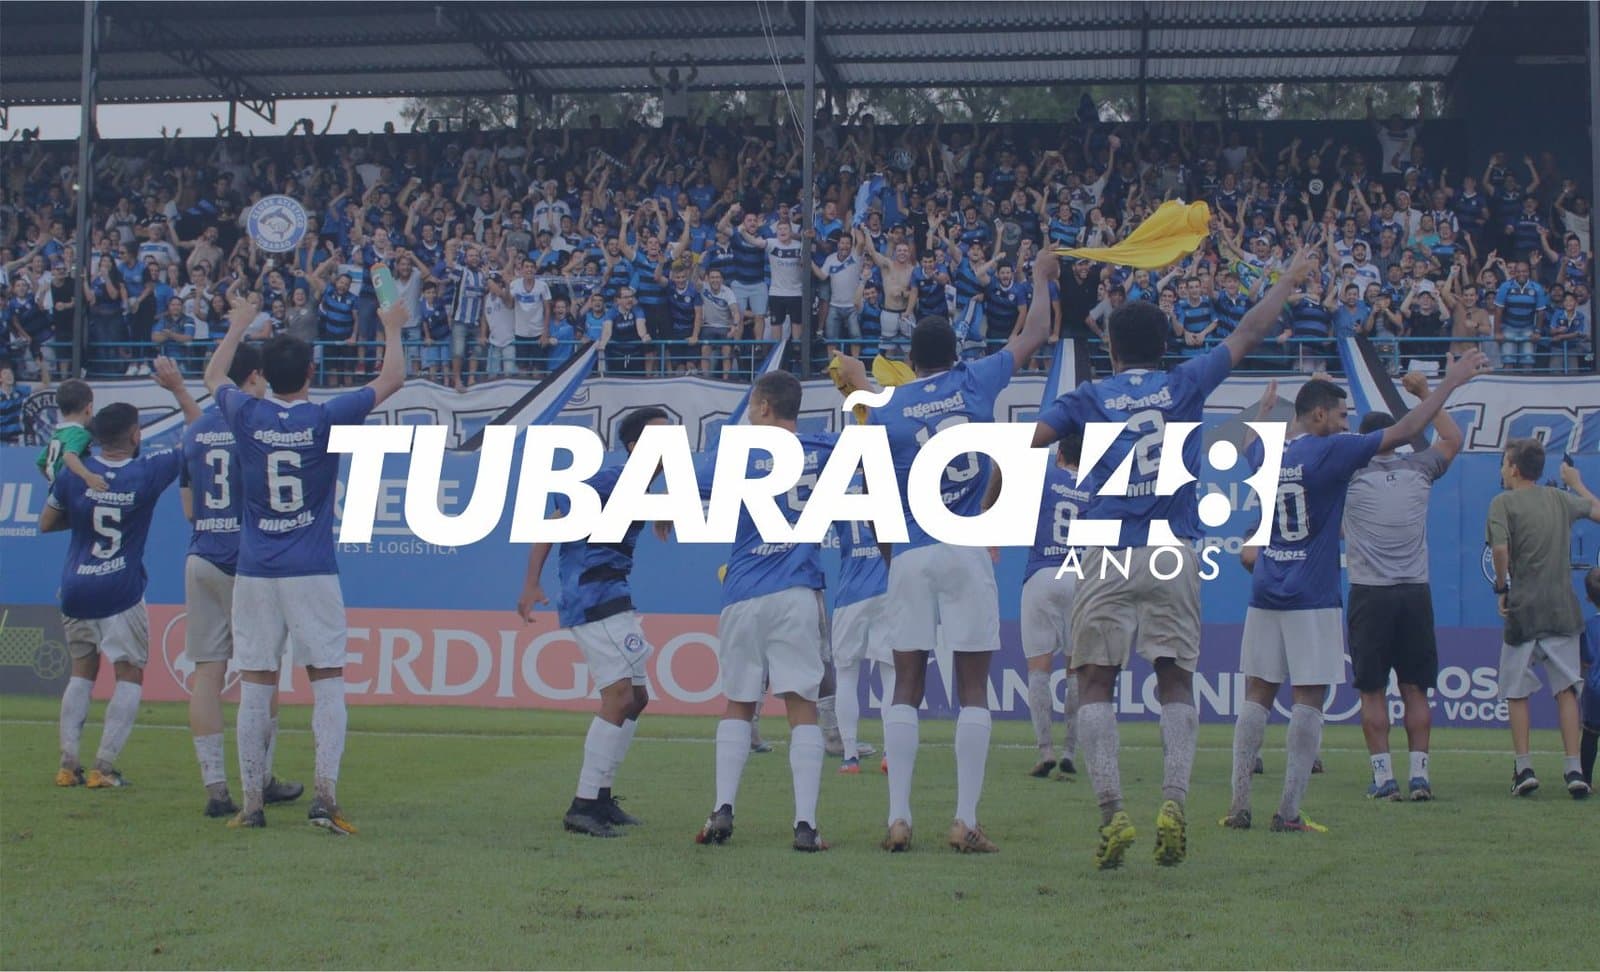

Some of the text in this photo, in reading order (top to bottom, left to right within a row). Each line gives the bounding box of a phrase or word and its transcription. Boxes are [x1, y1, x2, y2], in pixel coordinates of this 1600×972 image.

[902, 390, 963, 418] agemed
[254, 428, 313, 444] agemed
[205, 449, 231, 509] 3
[267, 450, 304, 513] 6
[91, 506, 123, 559] 5
[279, 625, 726, 703] ERDIGO
[1385, 666, 1499, 699] AOS
